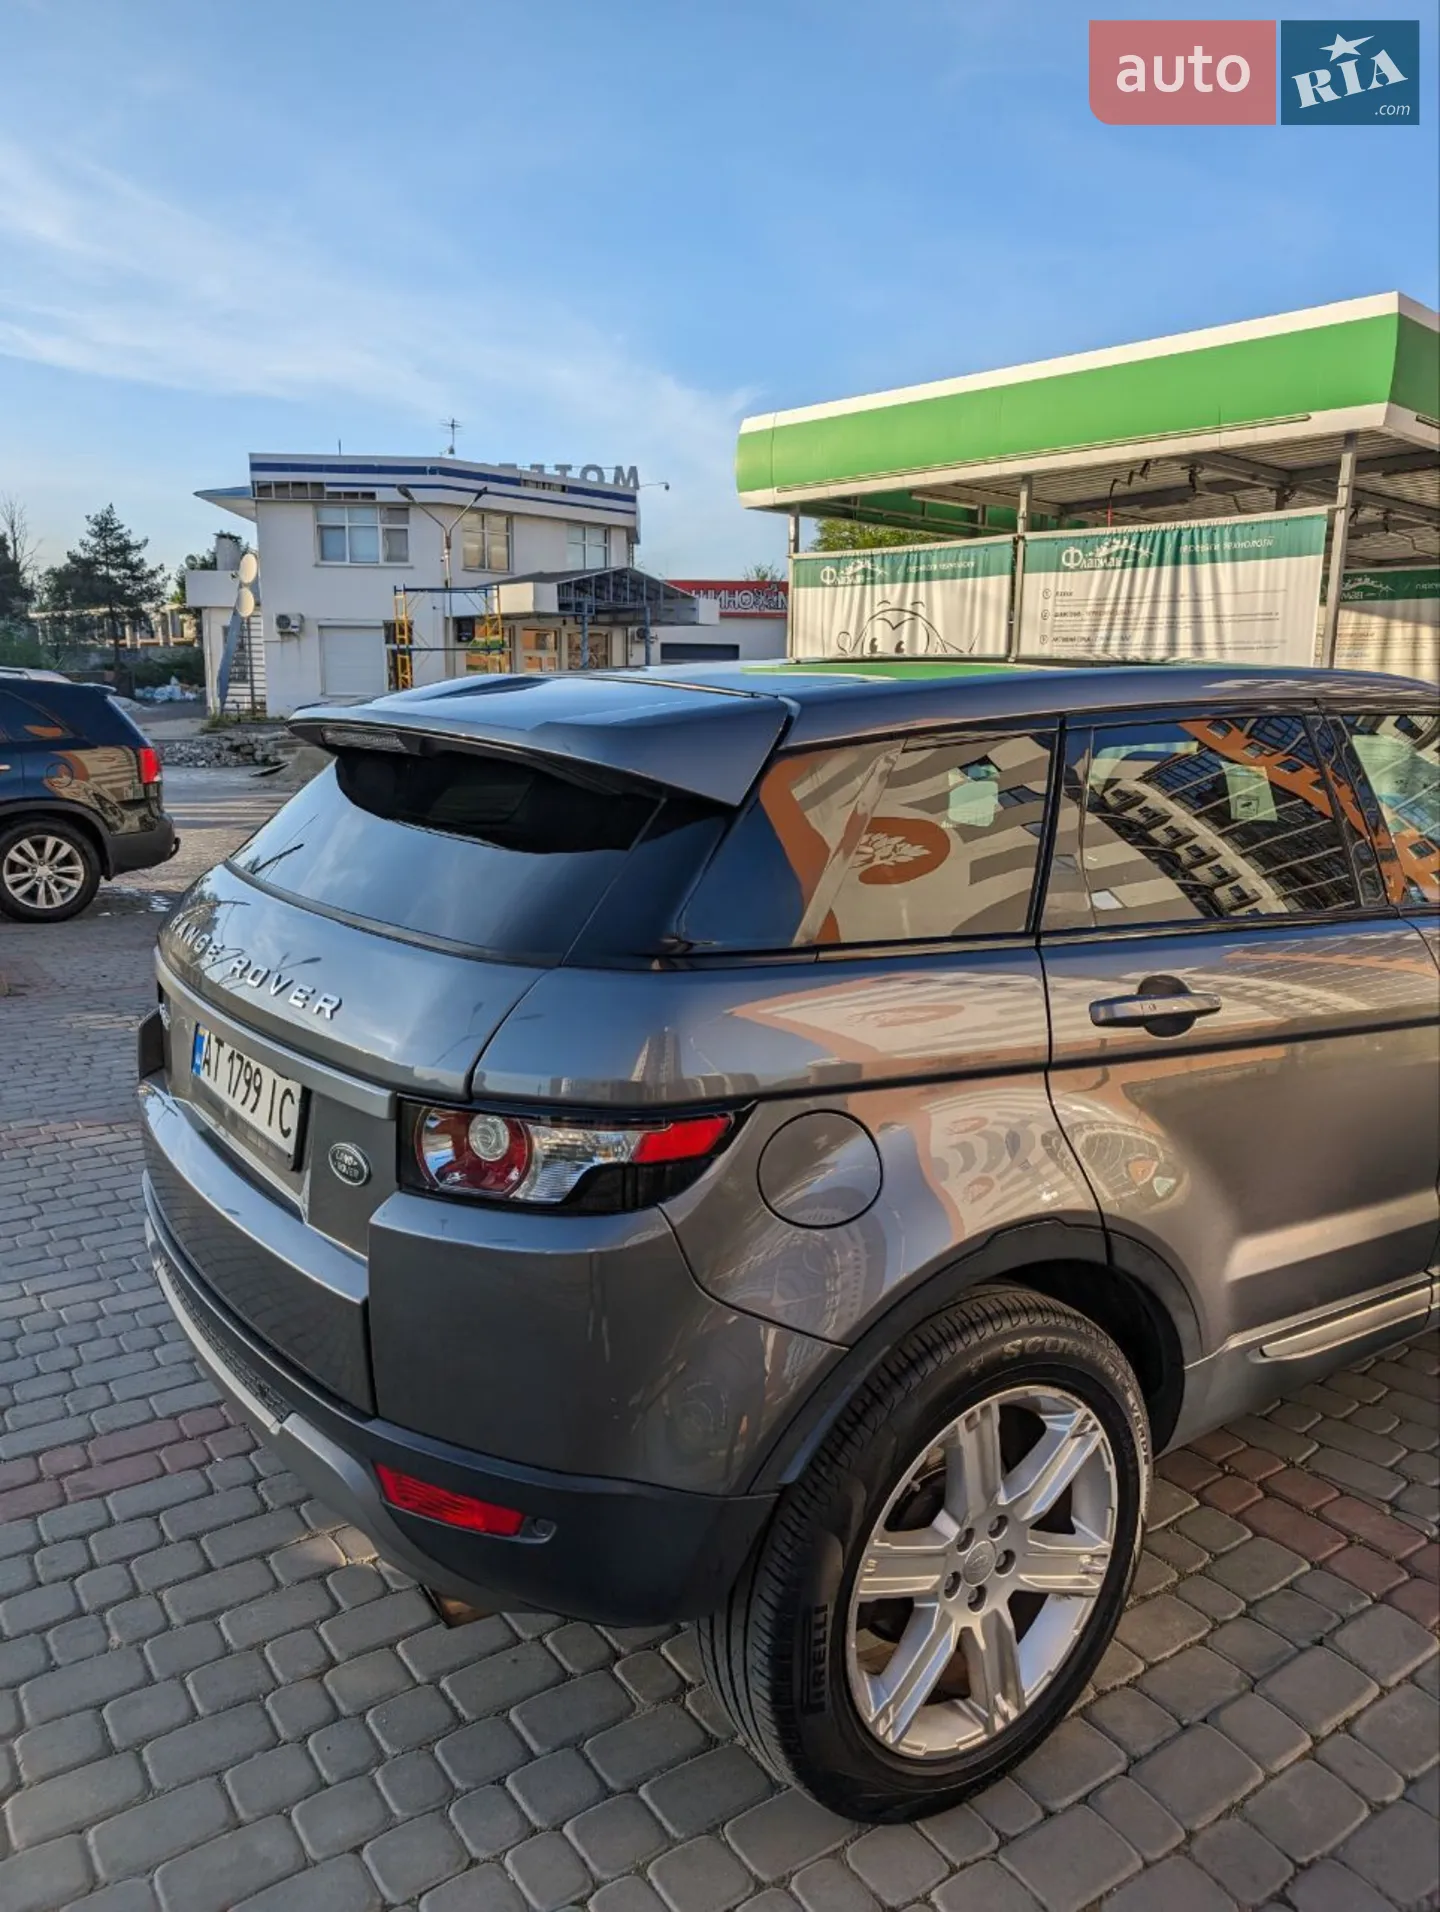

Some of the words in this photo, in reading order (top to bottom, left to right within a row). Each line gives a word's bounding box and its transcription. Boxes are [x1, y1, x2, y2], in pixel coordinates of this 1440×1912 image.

[169, 913, 225, 962] RANGE
[229, 957, 343, 1020] ROVER
[203, 1032, 224, 1083] AT
[228, 1049, 263, 1113] 1799
[268, 1078, 295, 1138] IC
